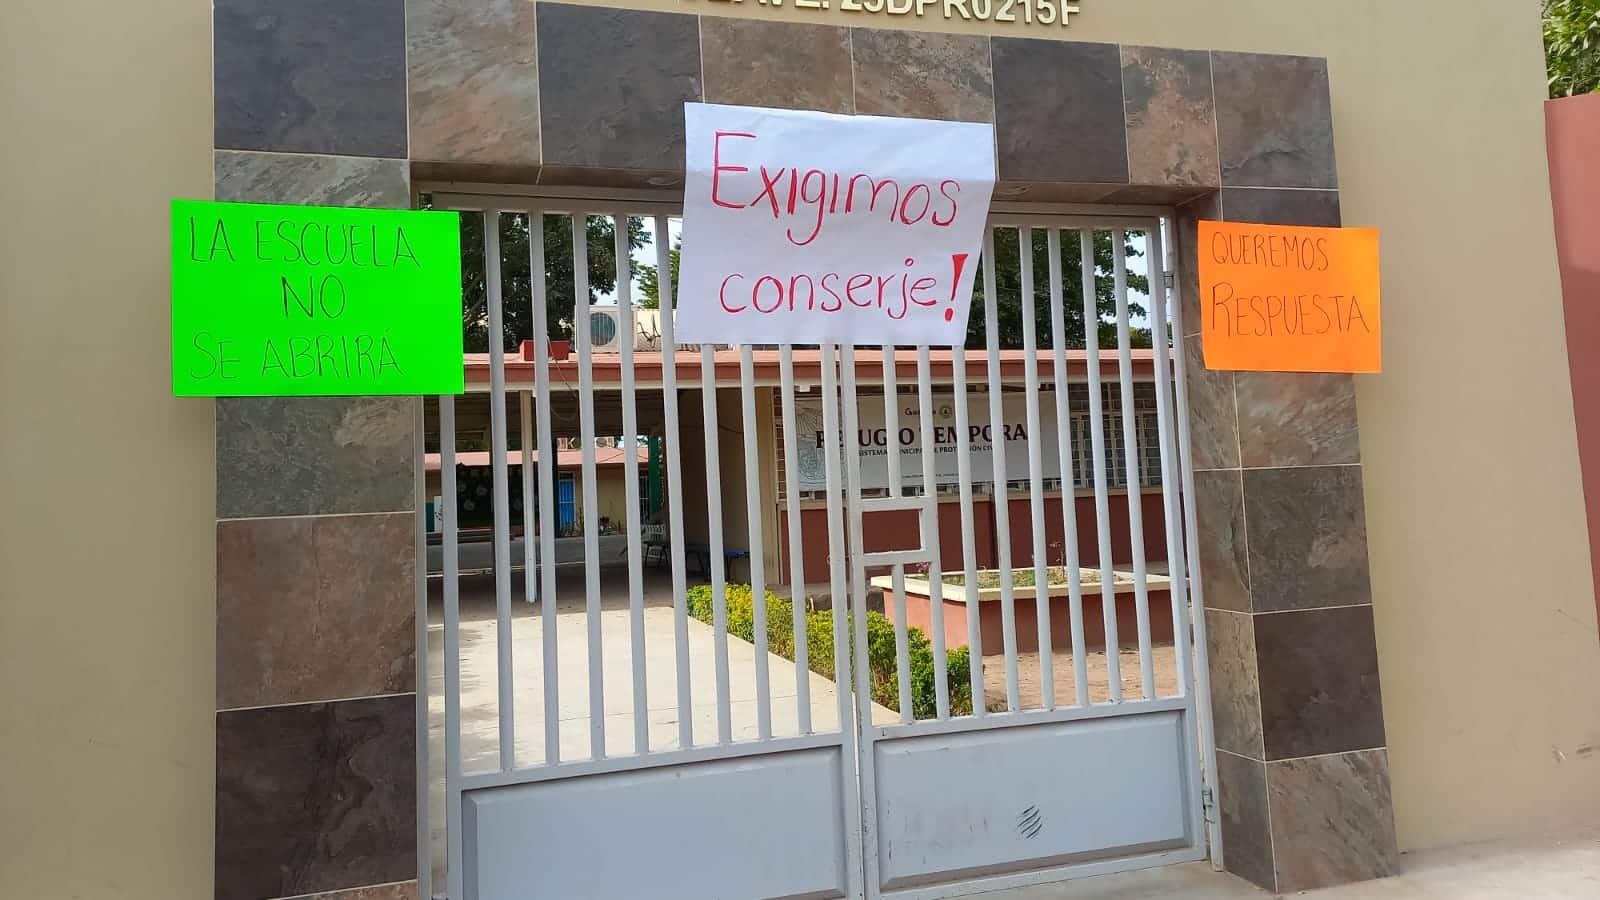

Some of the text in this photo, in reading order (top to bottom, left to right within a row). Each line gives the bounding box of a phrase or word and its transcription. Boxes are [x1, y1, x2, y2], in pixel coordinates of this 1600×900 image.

[712, 131, 960, 245] Exigimos
[189, 215, 421, 269] LA ESCUELA
[1212, 231, 1329, 271] QUEREMOS
[281, 274, 346, 319] NO
[719, 253, 969, 321] conserje!
[190, 327, 408, 383] SE ABRIRÁ
